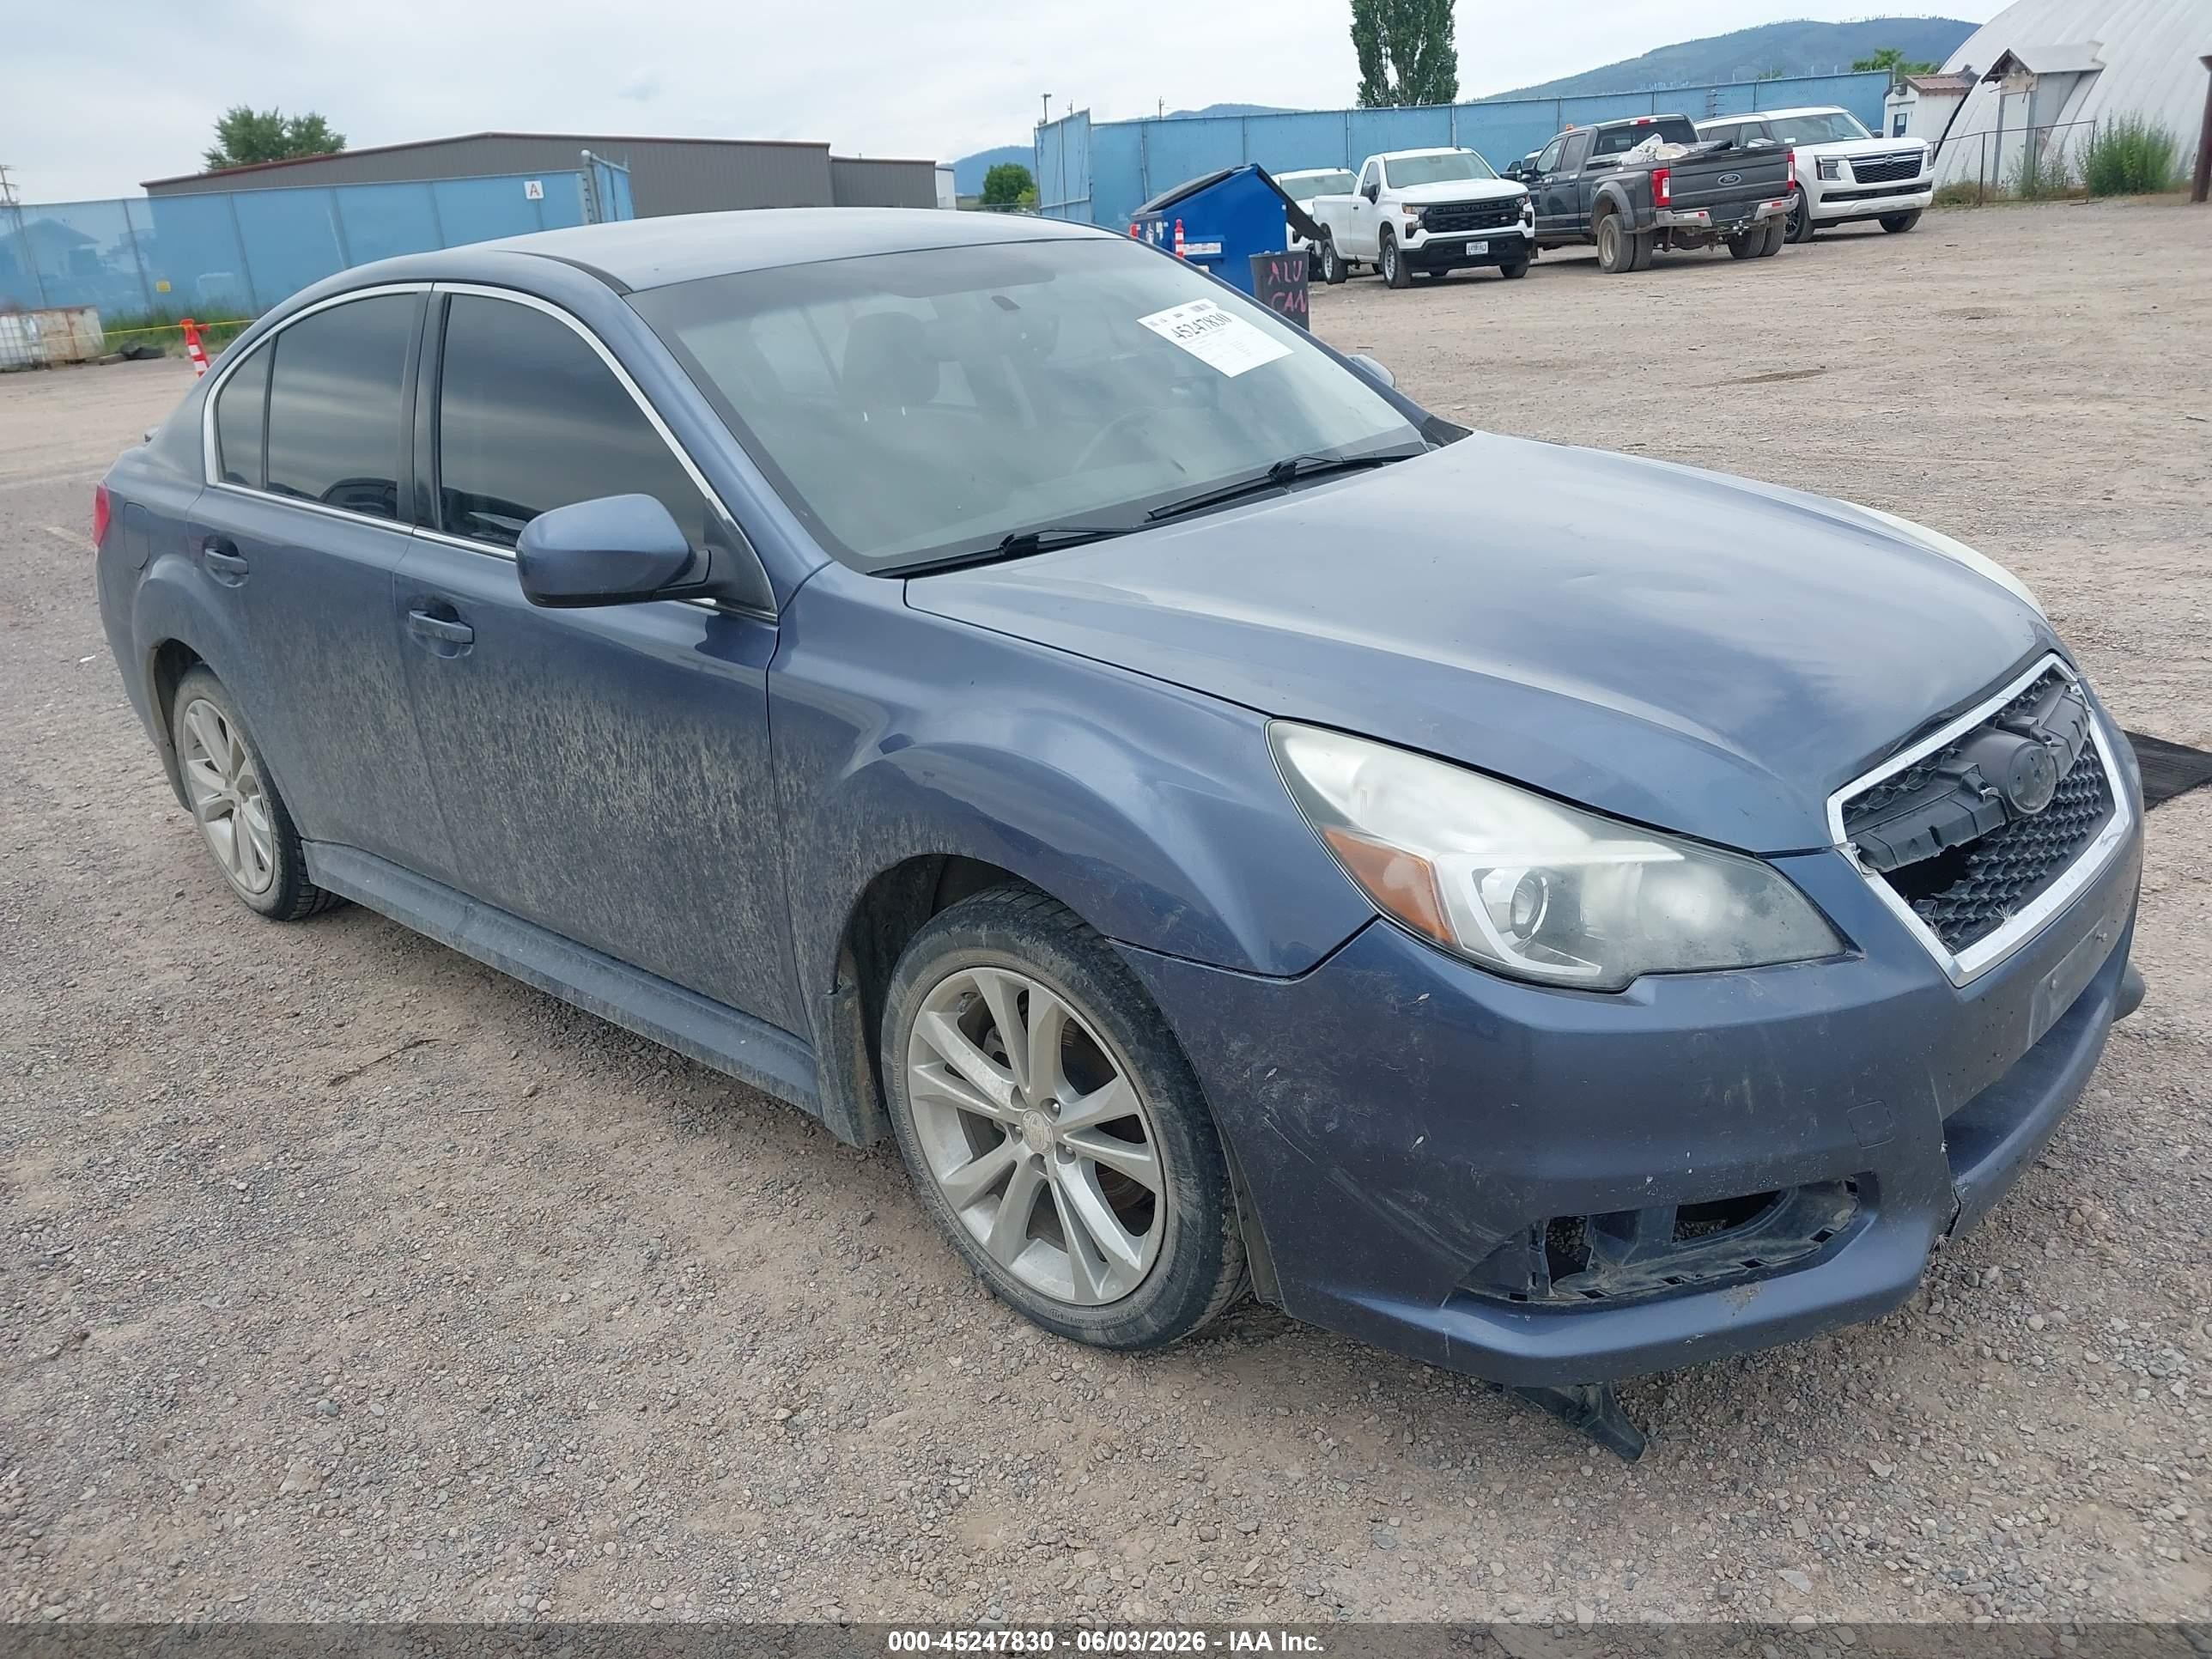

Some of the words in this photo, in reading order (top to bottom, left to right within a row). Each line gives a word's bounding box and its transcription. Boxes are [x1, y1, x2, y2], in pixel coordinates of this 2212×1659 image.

[529, 183, 540, 197] A
[1434, 200, 1516, 214] CHEVROLET
[1267, 260, 1303, 285] ALU
[1271, 289, 1306, 313] CAN
[1170, 312, 1232, 339] 45247830
